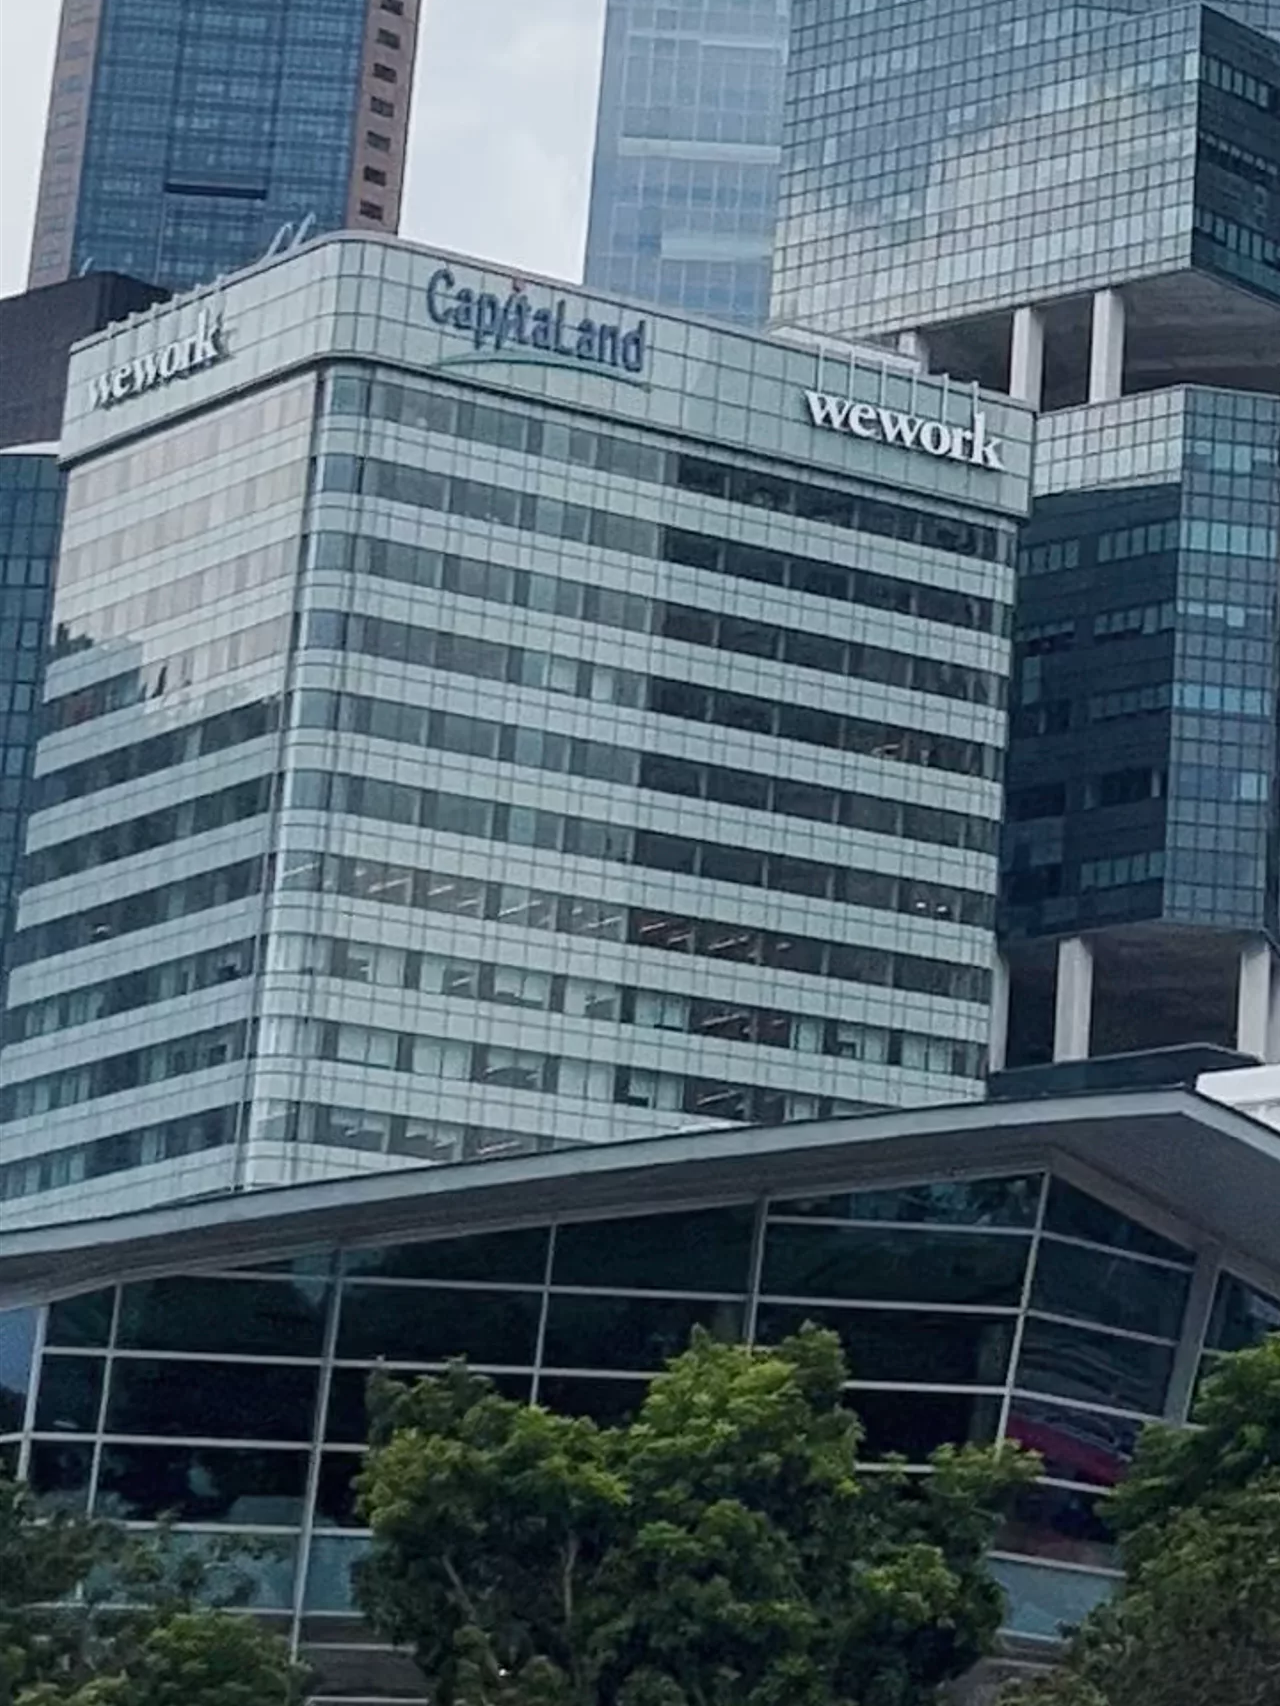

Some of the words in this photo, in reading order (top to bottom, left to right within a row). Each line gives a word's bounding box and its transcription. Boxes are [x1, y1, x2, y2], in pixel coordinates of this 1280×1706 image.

[89, 308, 219, 411] wework
[426, 269, 646, 373] CapitaLand
[803, 389, 1006, 470] wework
